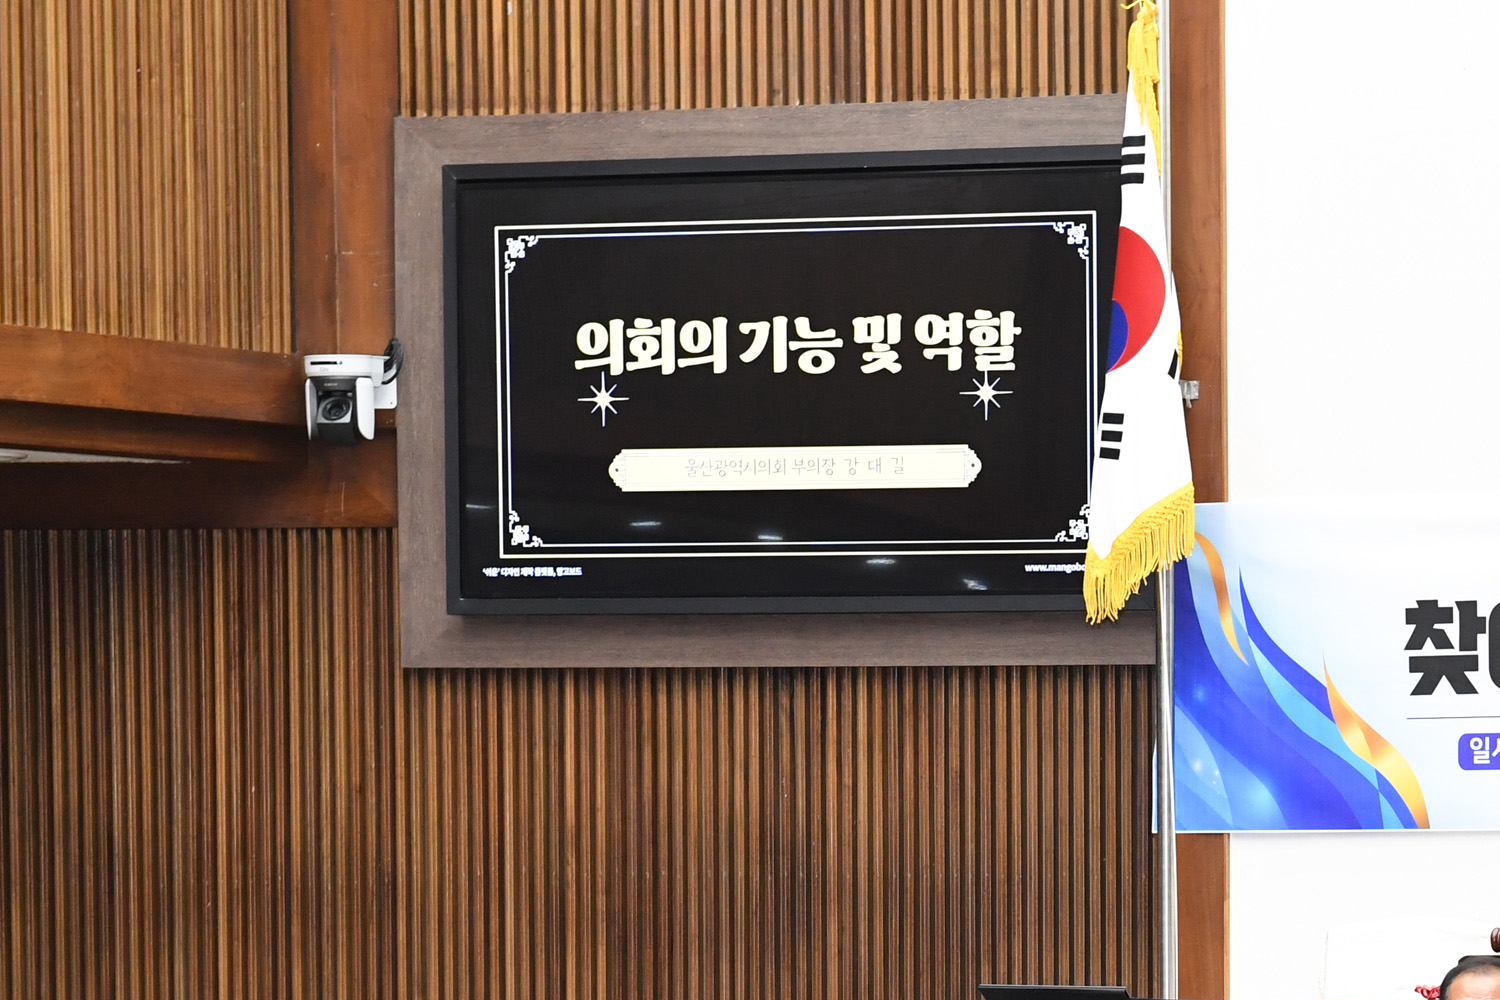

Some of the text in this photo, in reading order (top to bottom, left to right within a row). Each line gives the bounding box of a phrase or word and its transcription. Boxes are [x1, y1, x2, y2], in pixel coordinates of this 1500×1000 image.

[574, 308, 1022, 376] 의회의 기능 및 역할
[684, 458, 786, 478] 울산광역시의회
[791, 457, 837, 476] 부의장
